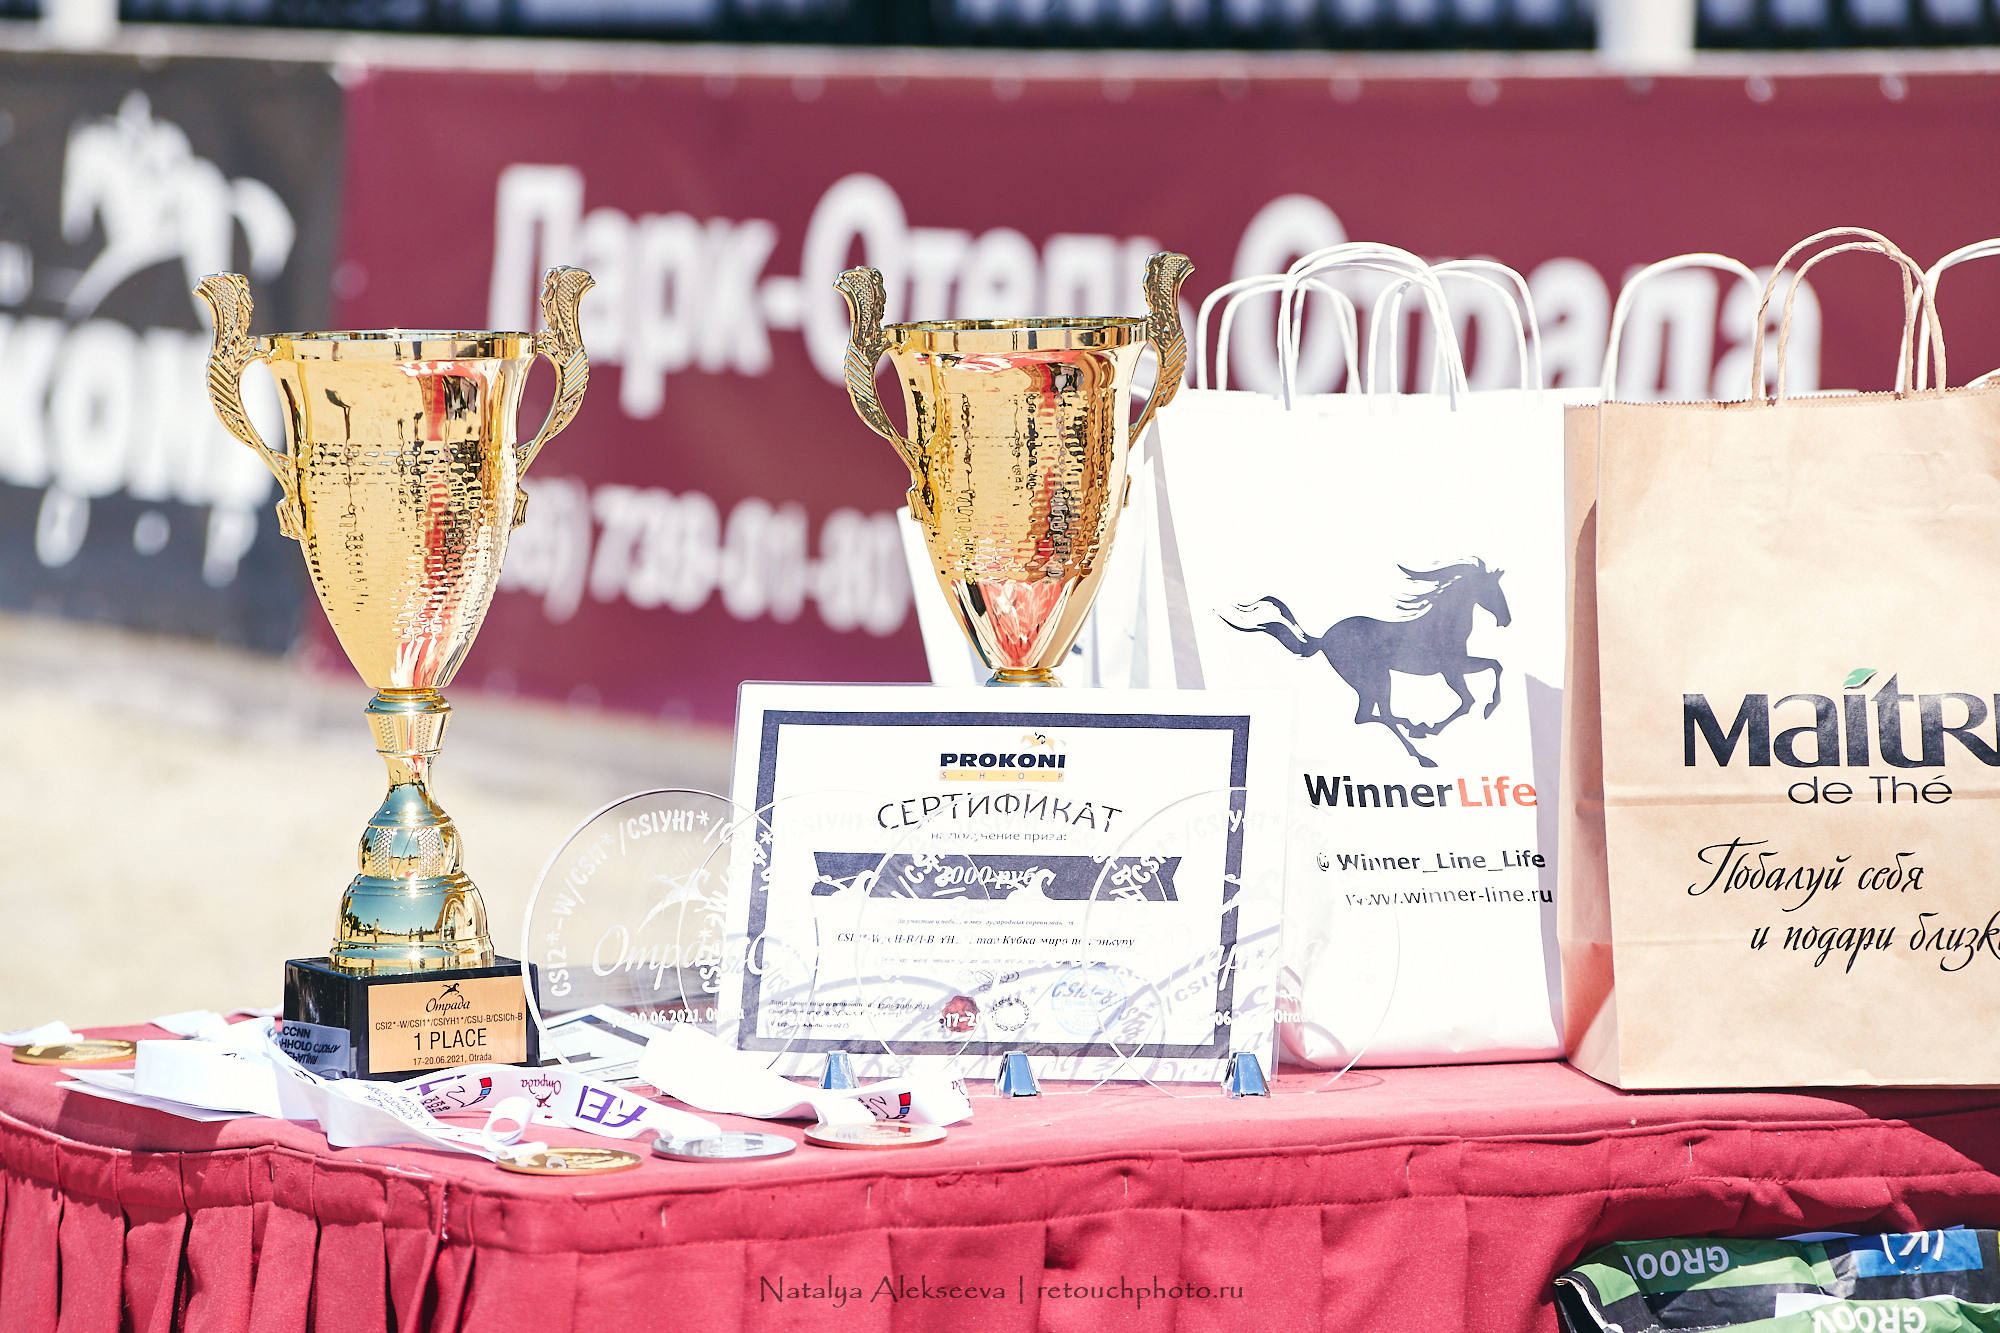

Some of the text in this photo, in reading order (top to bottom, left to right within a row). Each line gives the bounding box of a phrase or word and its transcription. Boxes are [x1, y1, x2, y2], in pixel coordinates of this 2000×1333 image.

[940, 753, 1066, 768] PROKONI
[1787, 774, 1953, 805] de Thé
[877, 793, 1123, 833] СЕРТИФИКАТ
[1687, 836, 1924, 912] Побалуй себя
[1750, 926, 1771, 950] и
[1783, 925, 1896, 974] подари
[414, 1028, 487, 1050] 1 PLACE
[469, 1053, 492, 1062] Otrada
